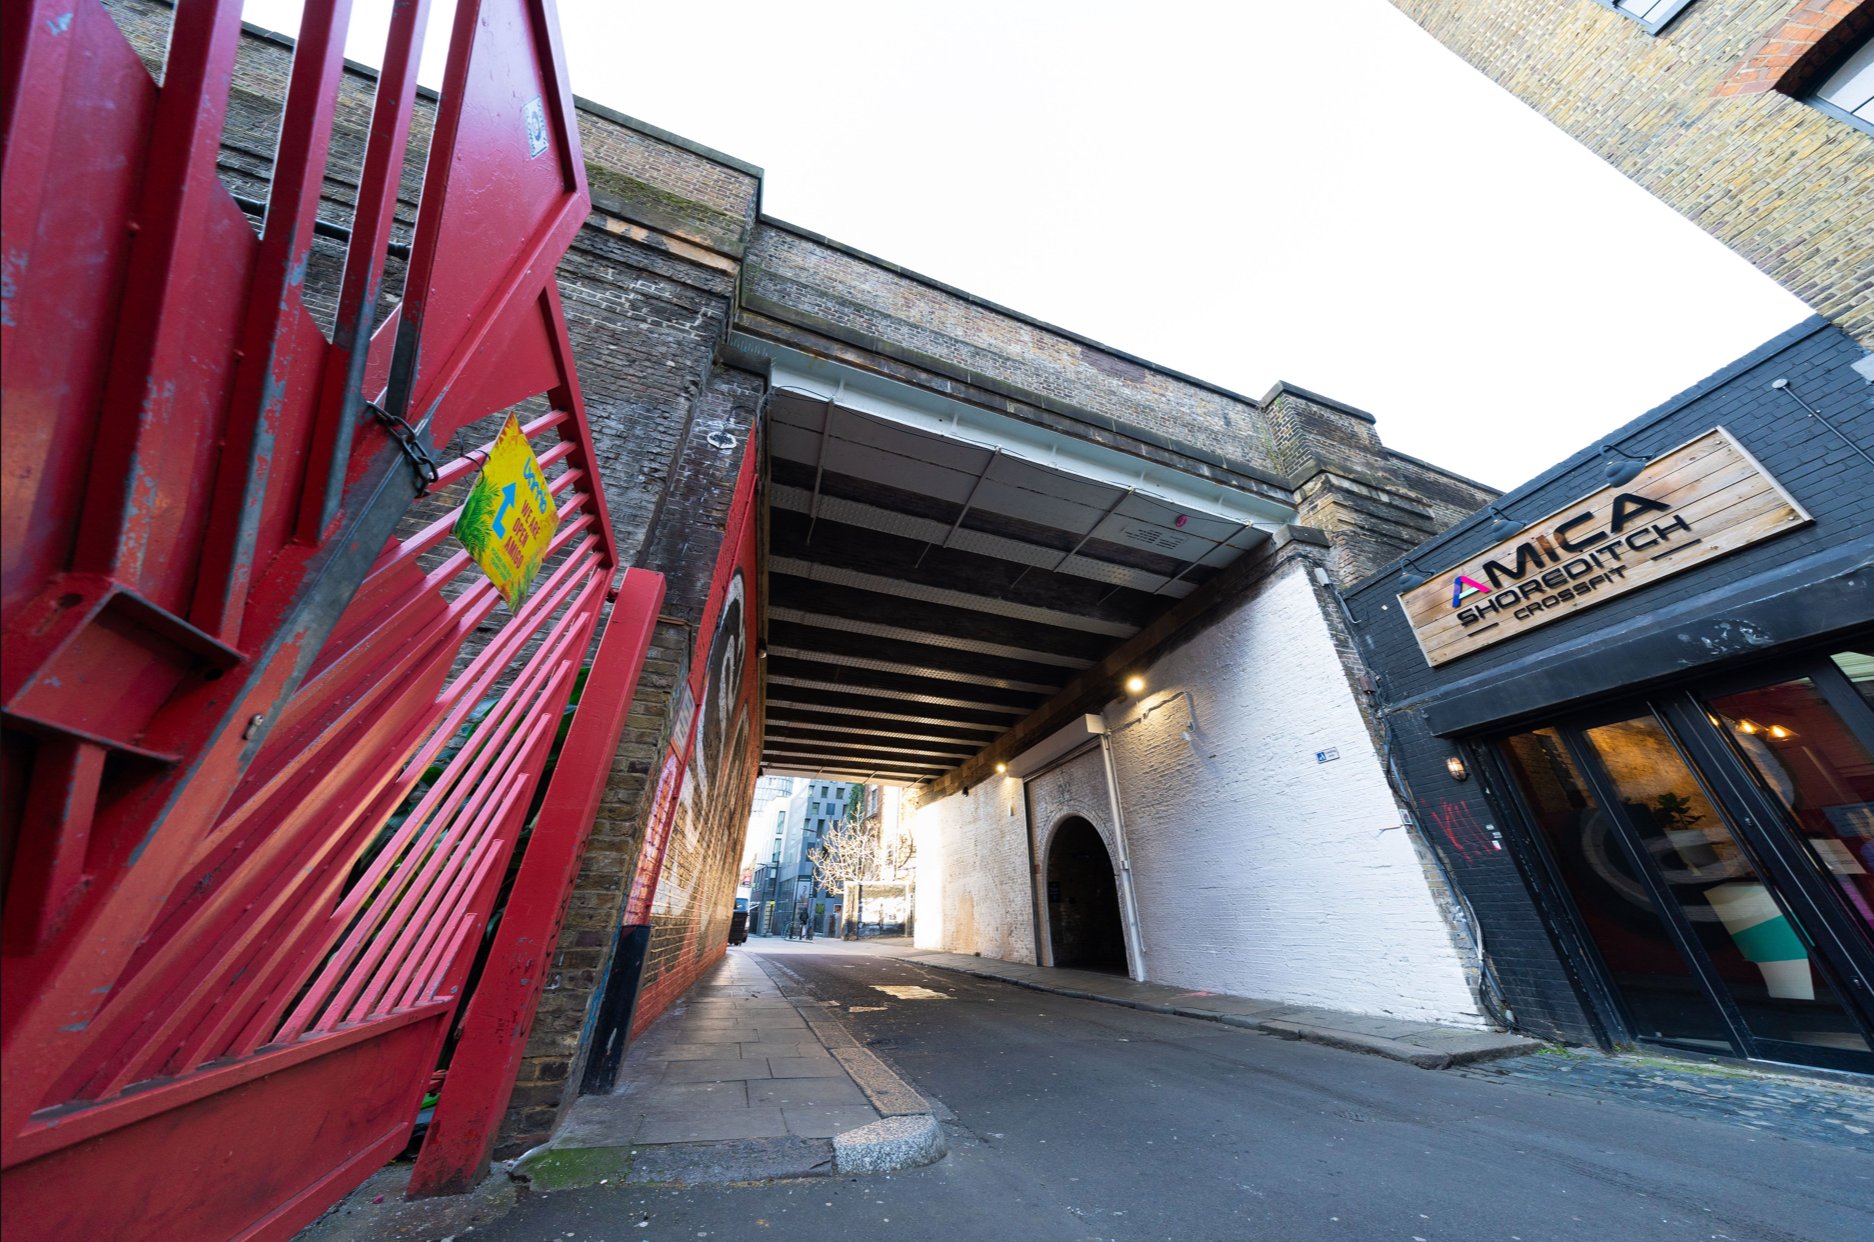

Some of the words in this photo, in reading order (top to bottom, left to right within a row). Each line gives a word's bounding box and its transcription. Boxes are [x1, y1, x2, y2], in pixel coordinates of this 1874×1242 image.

[512, 517, 529, 548] OPEN
[521, 499, 533, 524] WE
[528, 517, 541, 540] ARE
[503, 536, 524, 569] AMIGO
[1453, 493, 1671, 608] AMICA
[1456, 514, 1692, 627] SHOREDITCH
[1513, 565, 1628, 621] CROSSFIT
